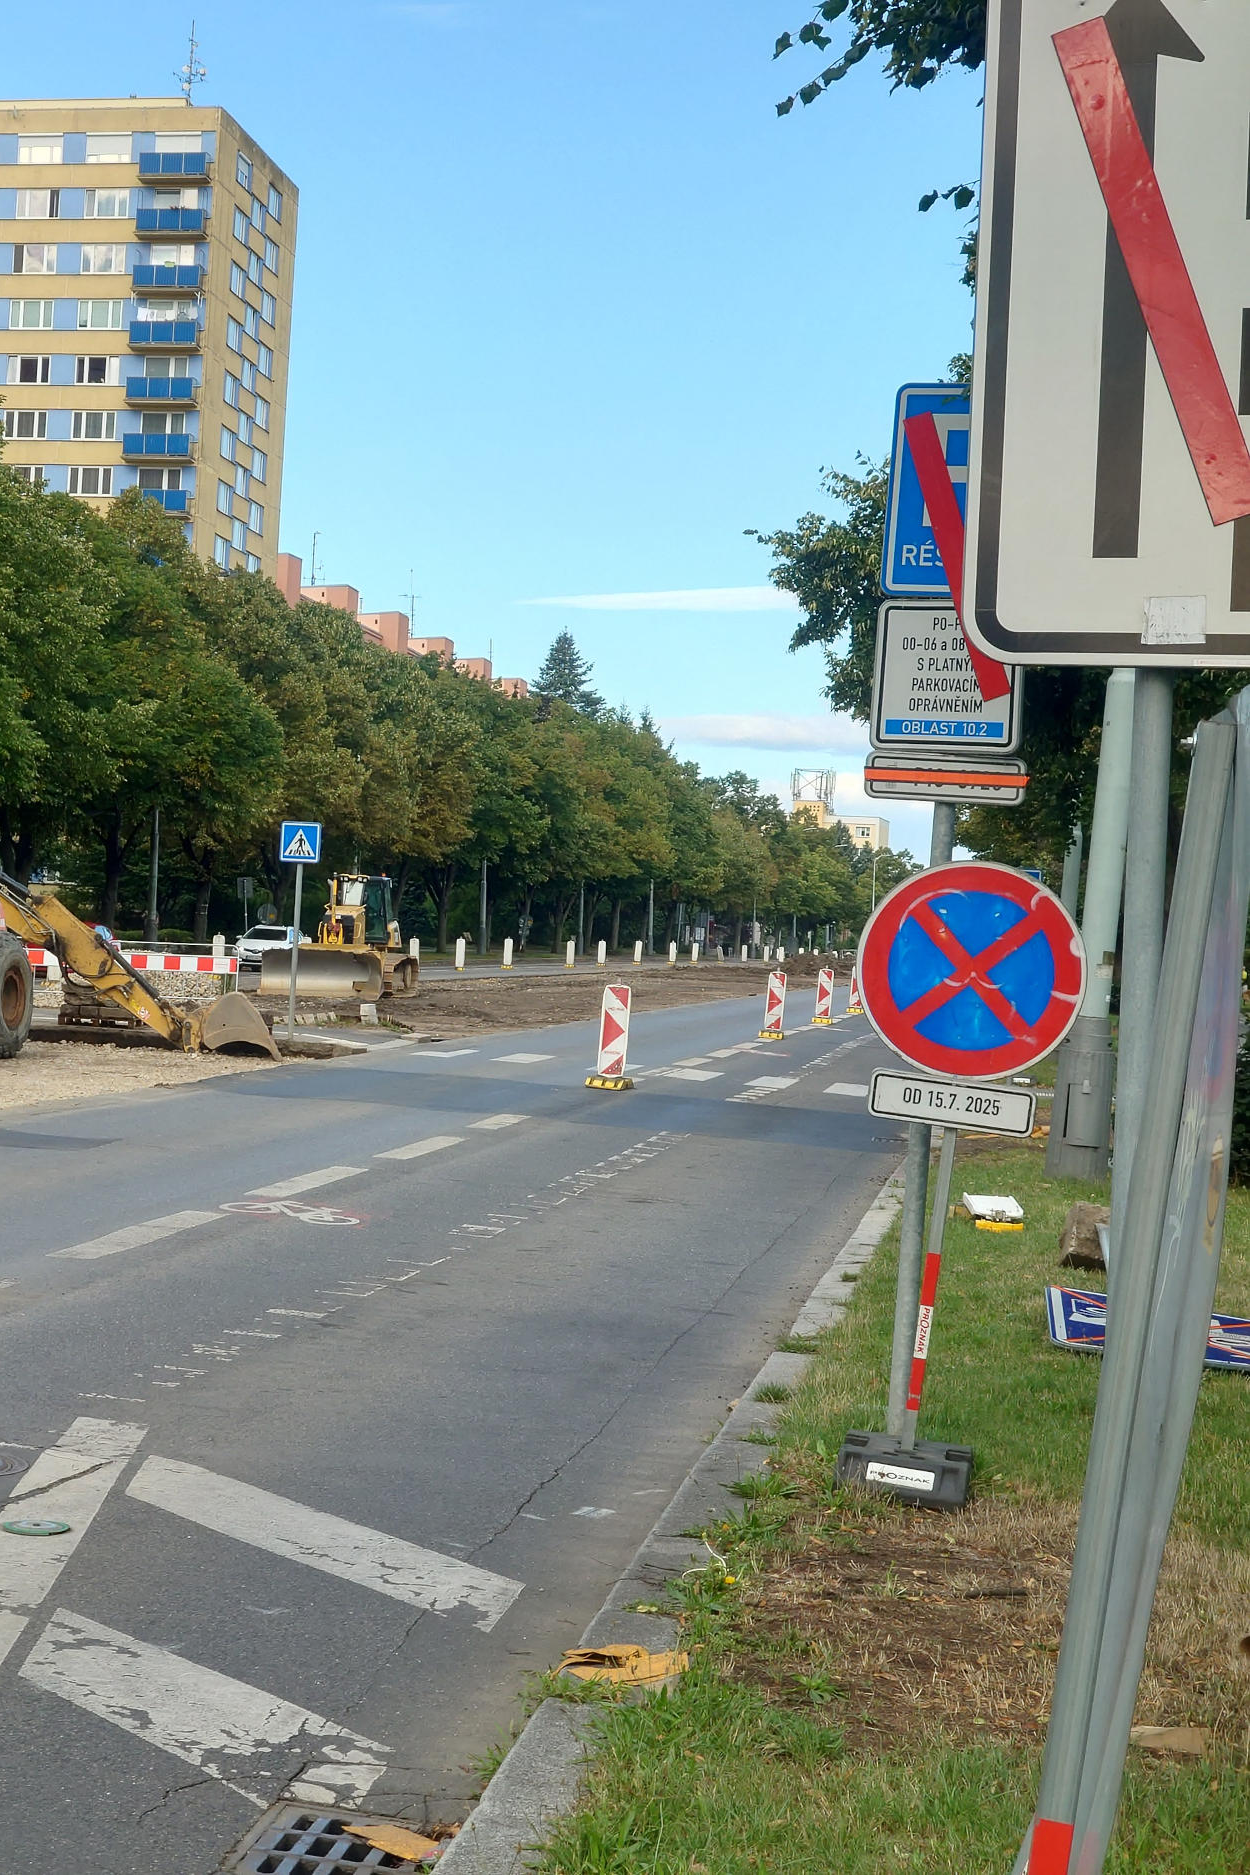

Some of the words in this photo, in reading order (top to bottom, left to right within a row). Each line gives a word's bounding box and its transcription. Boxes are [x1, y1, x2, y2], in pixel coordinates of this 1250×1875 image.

[901, 539, 944, 568] RÉS
[932, 617, 961, 631] PO-P
[902, 637, 937, 651] 00-06
[941, 641, 947, 650] a
[952, 637, 965, 651] 08
[917, 657, 924, 671] S
[908, 696, 983, 713] OPRÁVNĚNÍM
[901, 721, 957, 735] OBLAST
[962, 722, 988, 736] 10.2
[903, 1087, 922, 1105] OD
[965, 1095, 1001, 1116] 2025
[917, 1307, 930, 1354] PROZNAK
[870, 1470, 930, 1484] POZNAK
